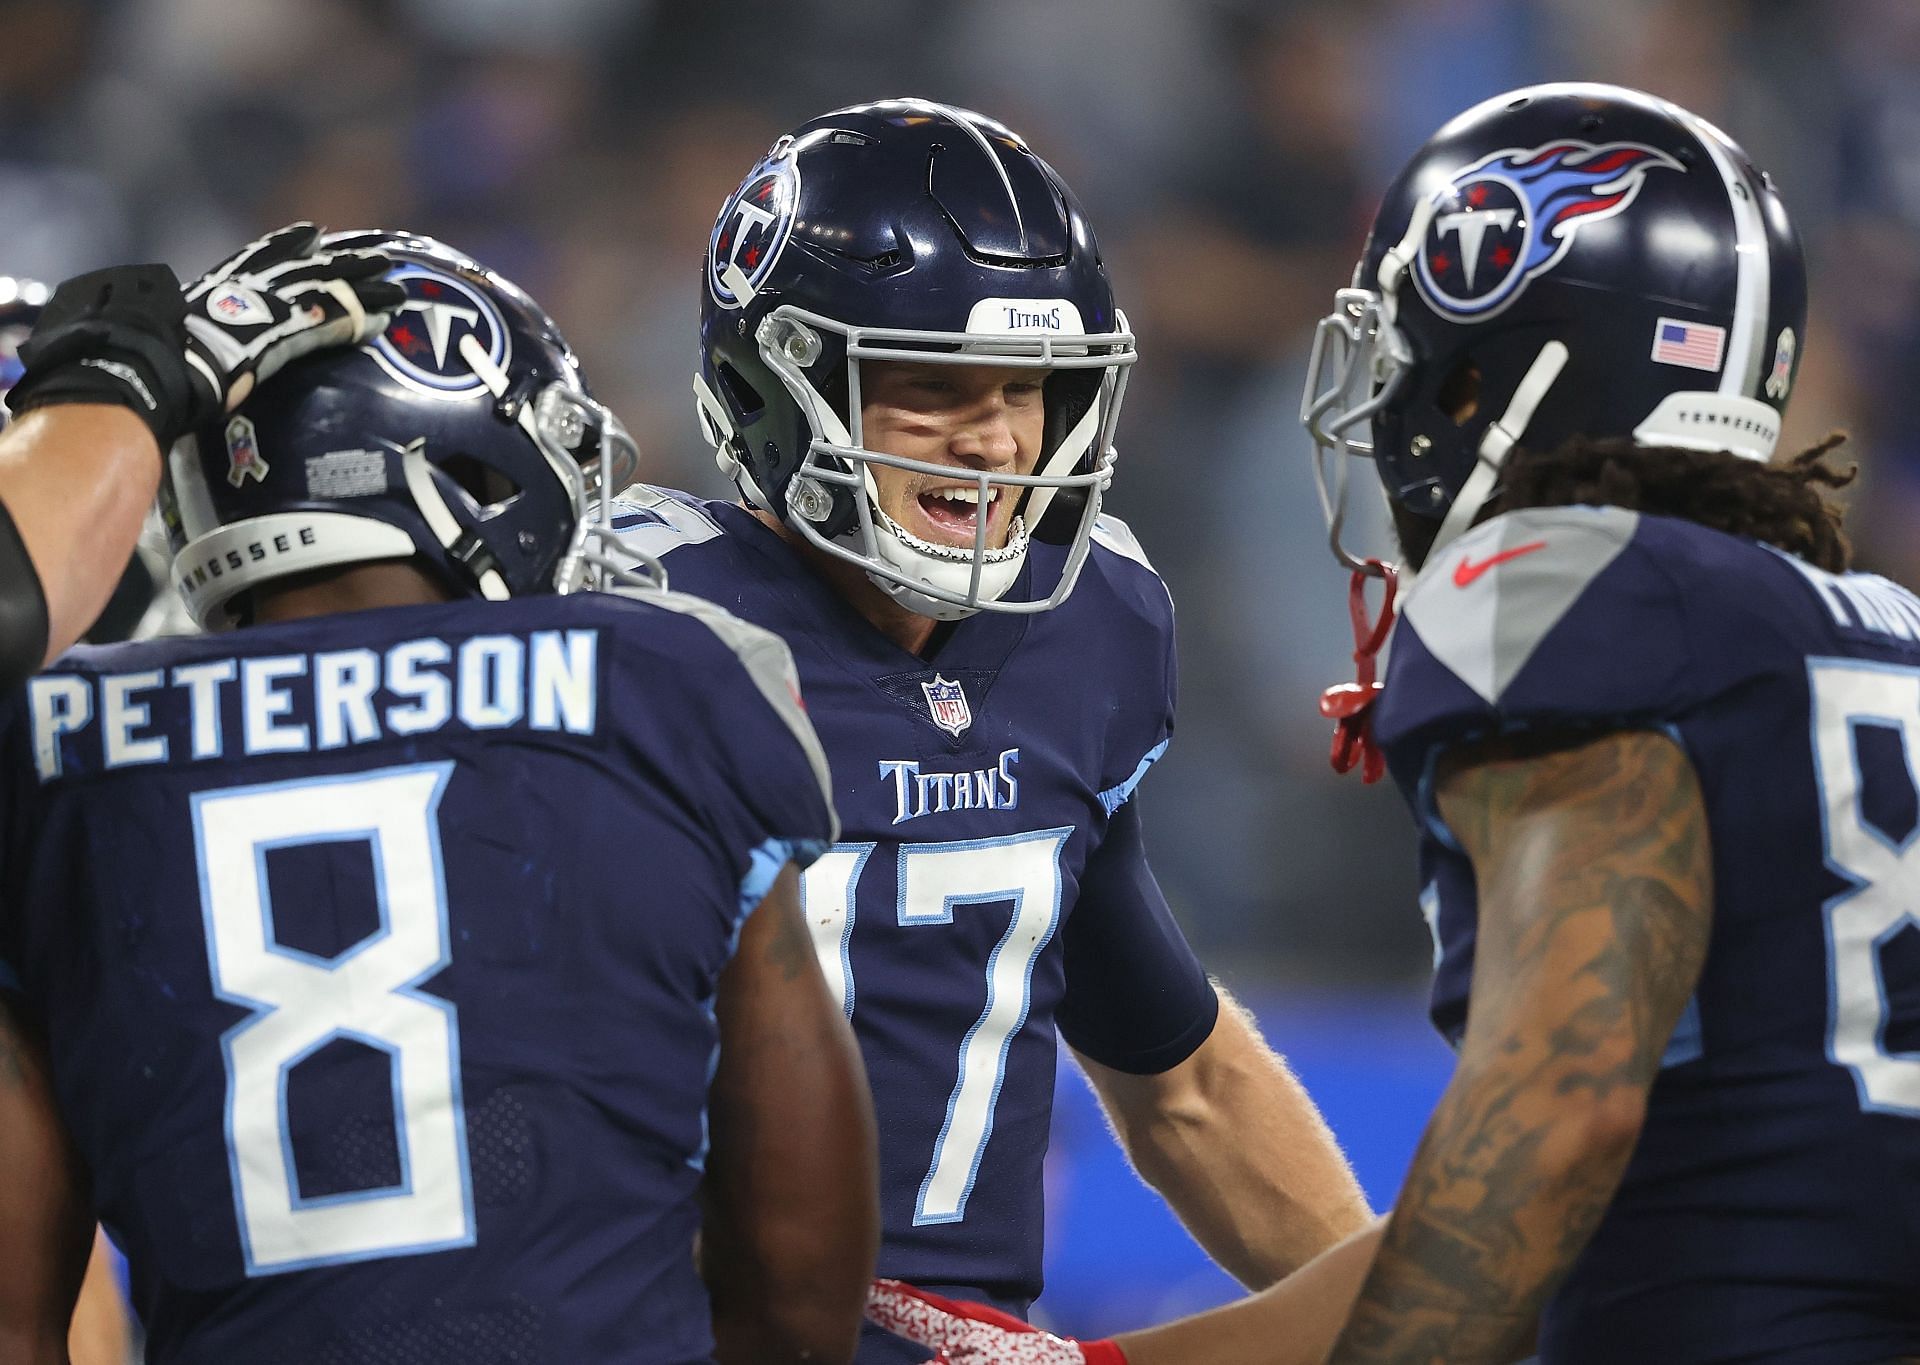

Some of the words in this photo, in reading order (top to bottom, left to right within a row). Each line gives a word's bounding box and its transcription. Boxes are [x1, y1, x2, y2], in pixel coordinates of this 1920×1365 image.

[1434, 207, 1518, 292] T
[179, 527, 316, 593] NNESSEE
[27, 630, 598, 780] PETERSON
[935, 701, 967, 724] NFL
[190, 761, 476, 1278] 8
